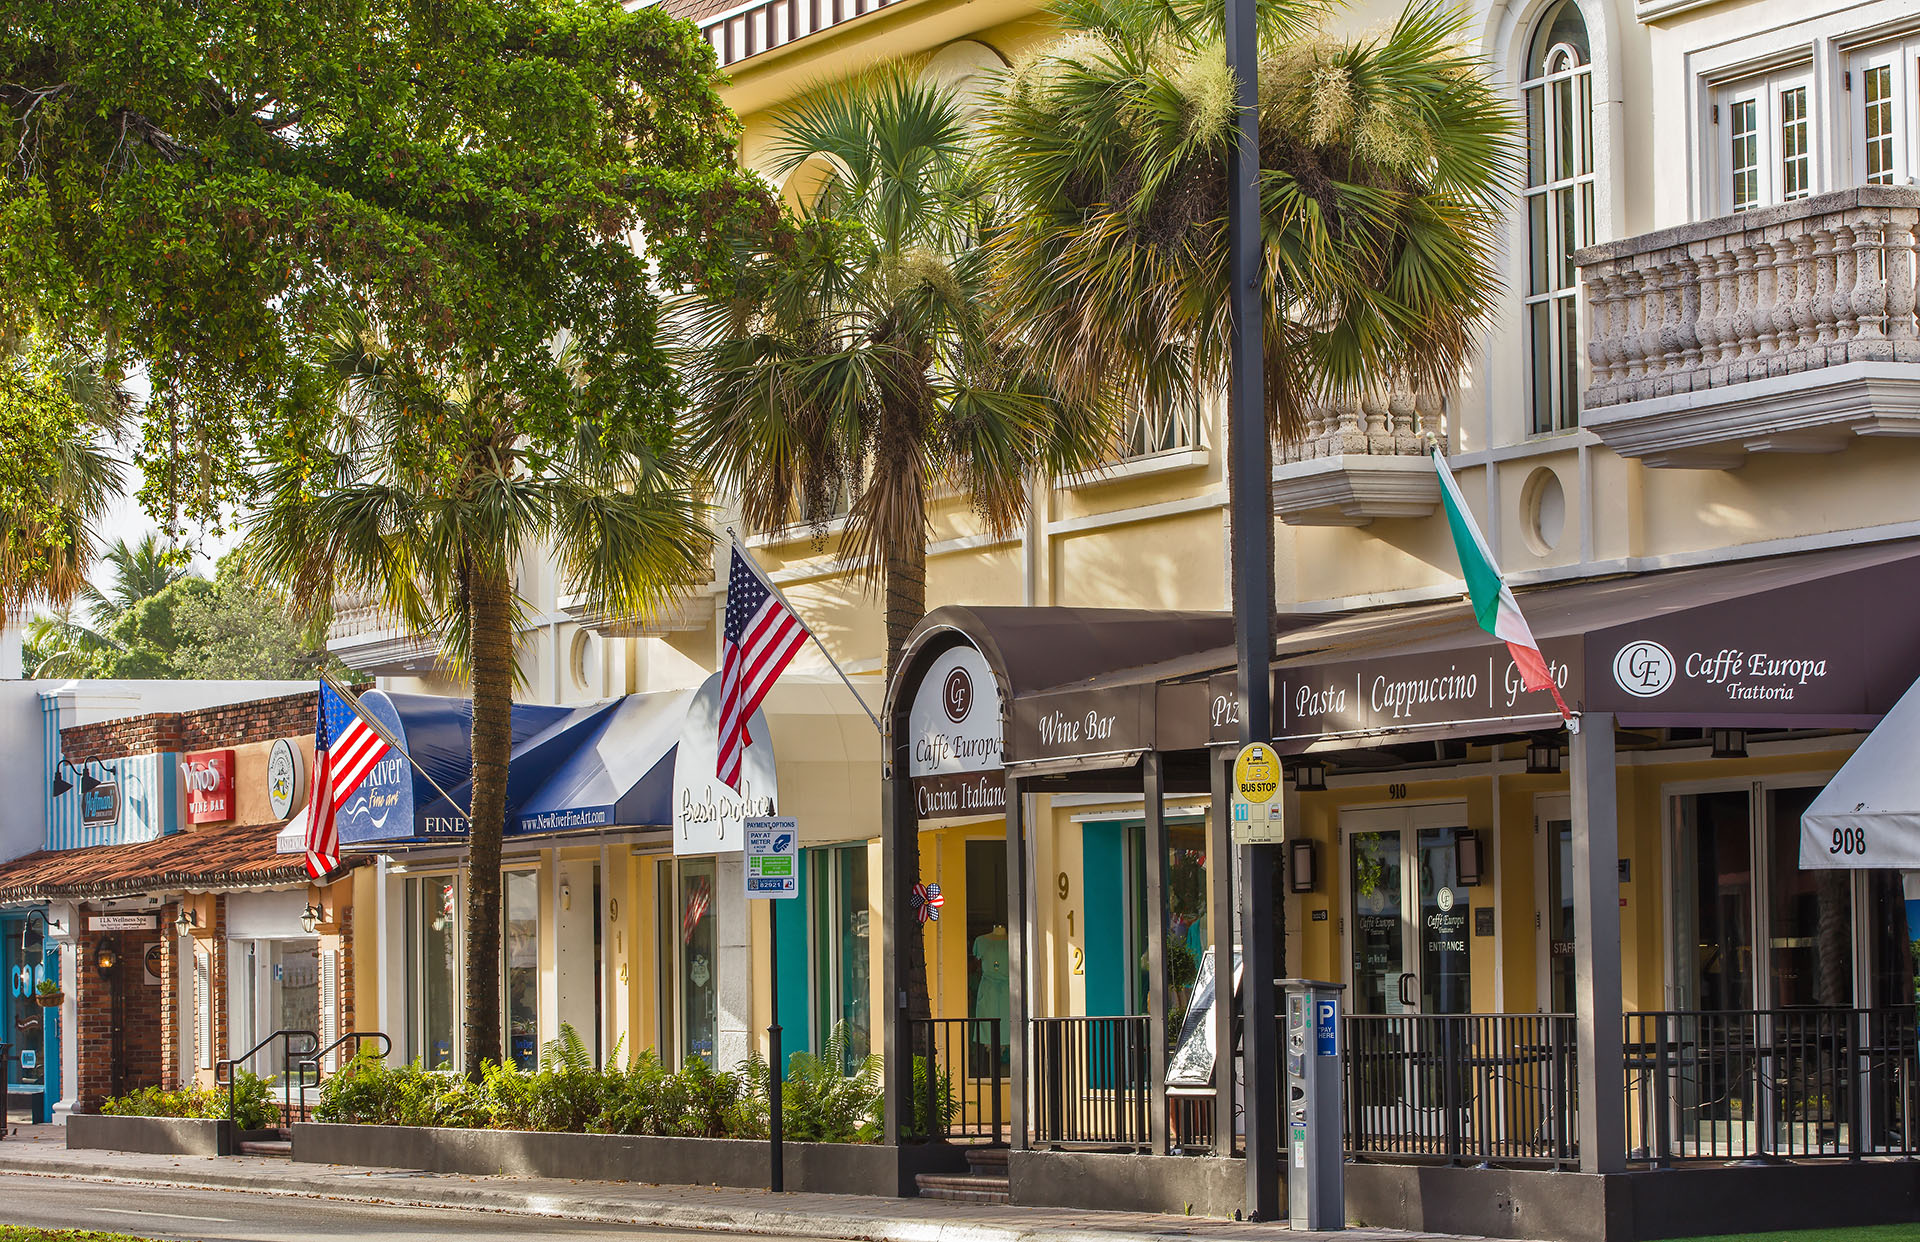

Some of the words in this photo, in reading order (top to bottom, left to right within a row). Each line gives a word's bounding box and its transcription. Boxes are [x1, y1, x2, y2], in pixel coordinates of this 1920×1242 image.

[1685, 649, 1744, 684] Caffé
[1747, 653, 1827, 685] Europa
[1371, 664, 1477, 719] Cappuccino
[1504, 659, 1569, 708] Geto
[1726, 682, 1794, 700] Trattoria
[1211, 691, 1239, 727] Piz
[1295, 682, 1347, 717] Pasta
[1038, 710, 1080, 746] Wine
[1084, 710, 1116, 741] Bar
[916, 734, 949, 770] Caffé
[368, 787, 385, 809] Fine
[1241, 783, 1256, 793] BUS
[1256, 782, 1277, 792] STOP
[1389, 783, 1406, 800] 910
[188, 801, 208, 815] WINE
[918, 783, 958, 816] Cucina
[521, 810, 606, 831] www.NewRiverFineArt.com
[678, 784, 717, 840] fresh
[1236, 804, 1248, 820] 11
[424, 817, 466, 833] FINE
[1829, 827, 1867, 855] 908
[1427, 913, 1443, 929] Caffé
[1443, 915, 1464, 929] Europa
[1428, 941, 1465, 952] ENTRANCE
[1319, 1005, 1334, 1025] P
[1293, 1129, 1305, 1140] 516
